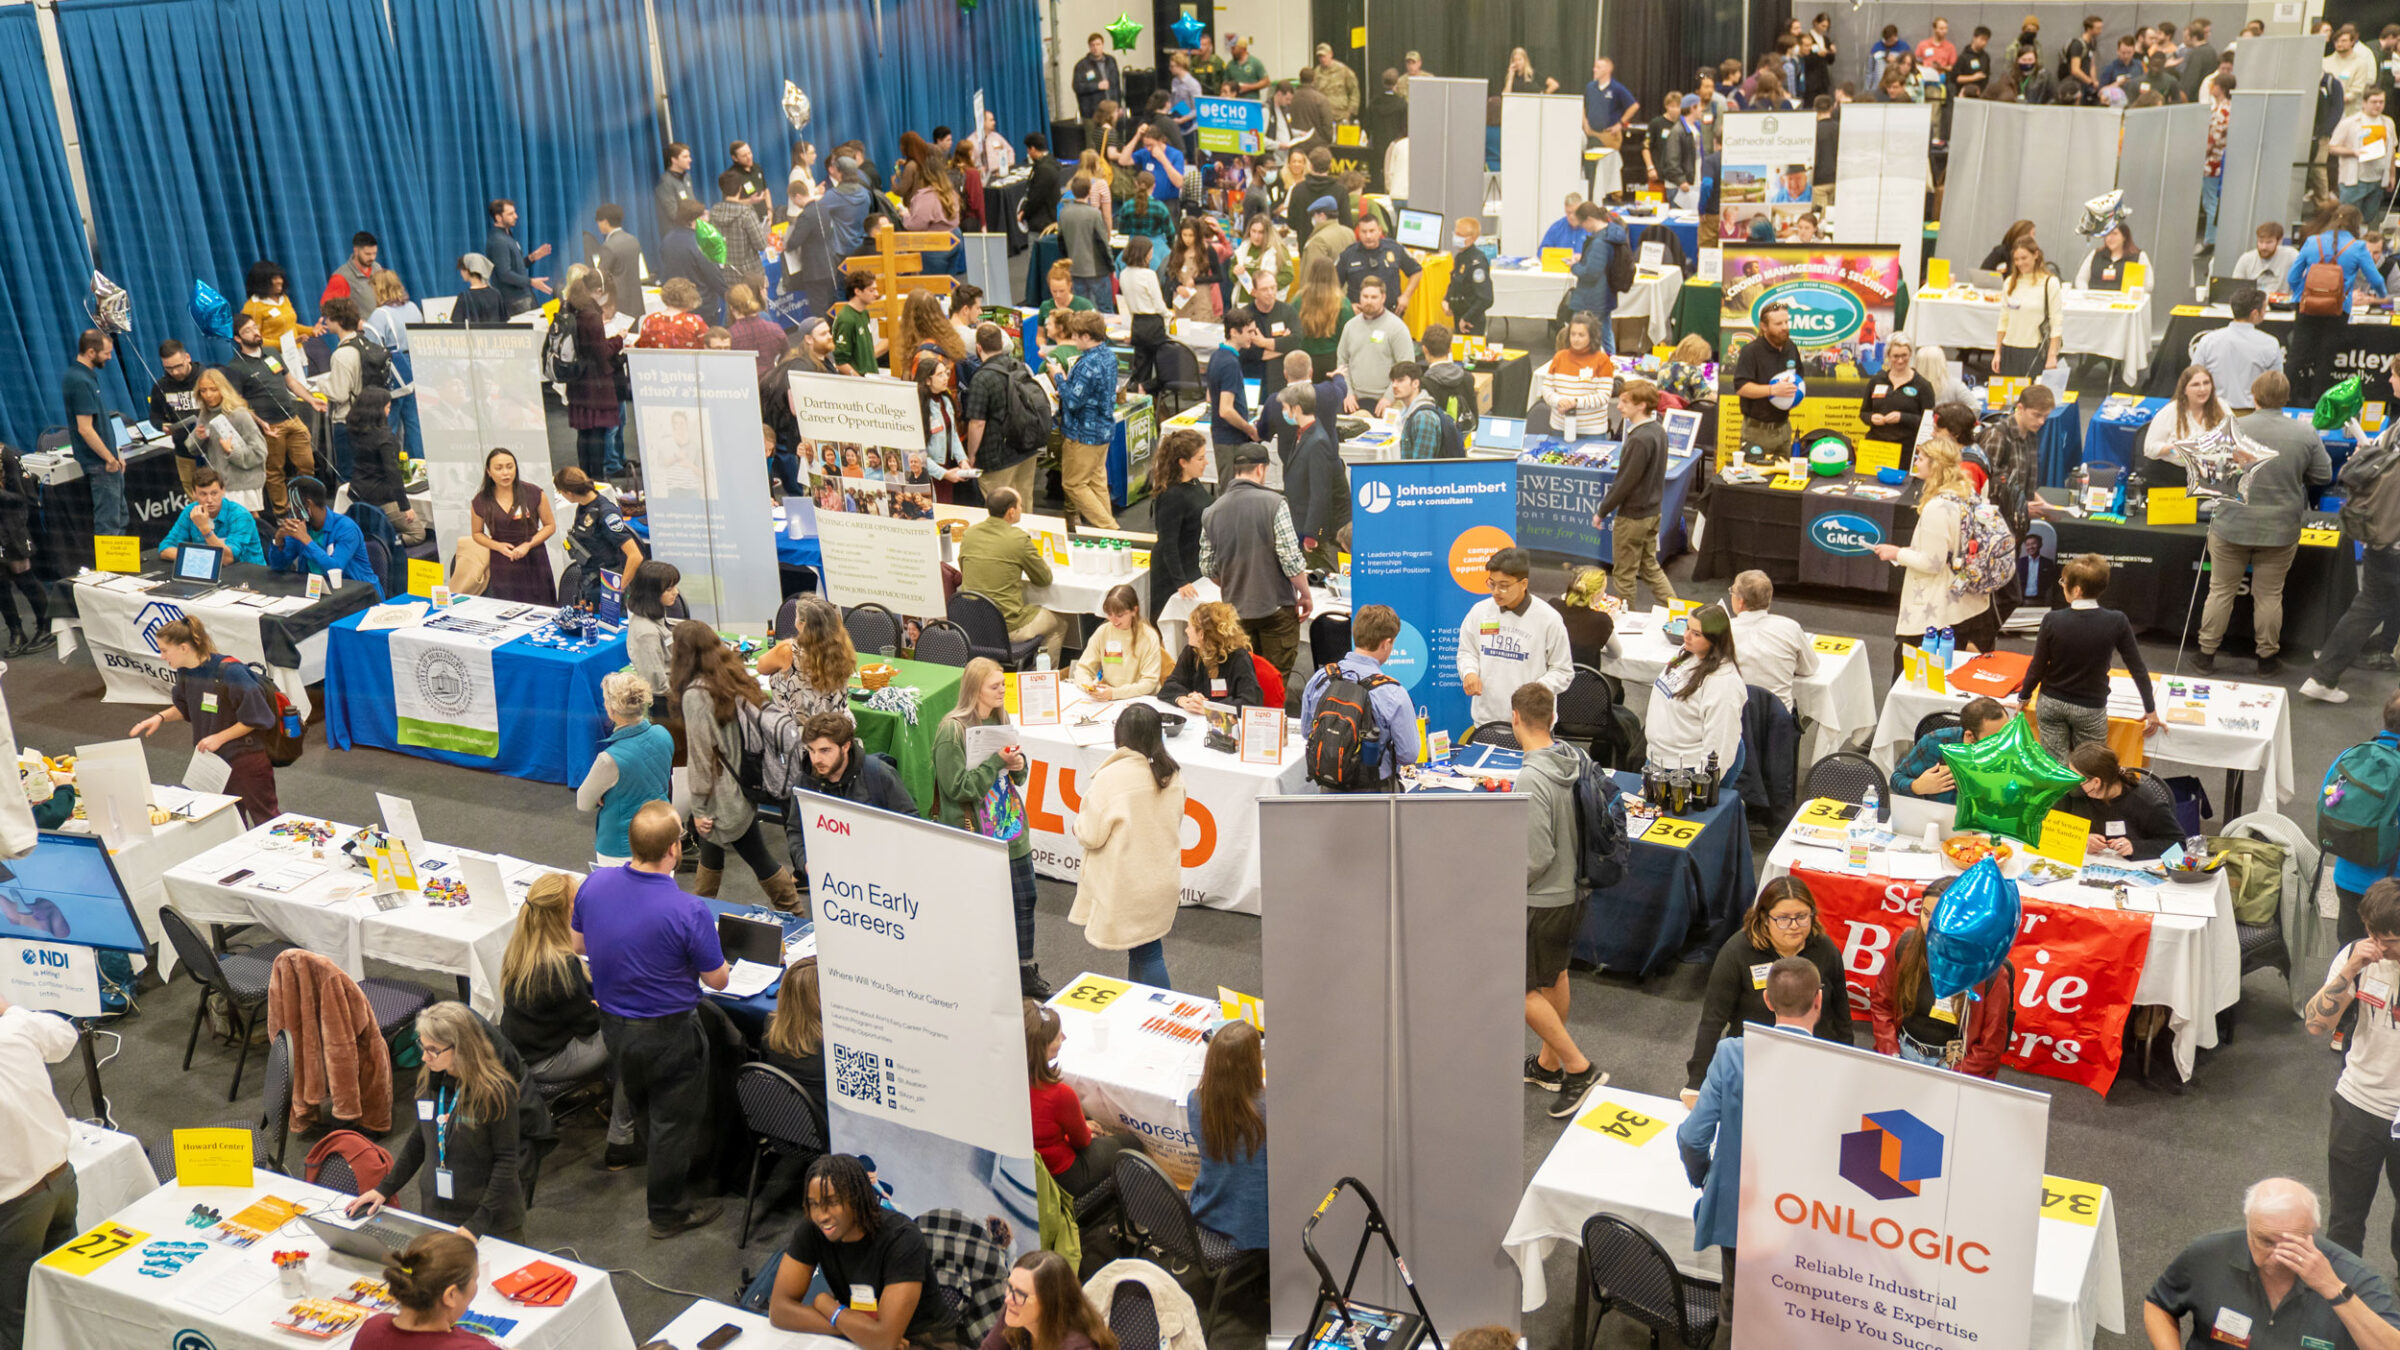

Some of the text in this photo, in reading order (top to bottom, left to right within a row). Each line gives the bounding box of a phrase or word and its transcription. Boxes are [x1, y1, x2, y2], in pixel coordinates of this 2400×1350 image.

[1725, 136, 1813, 148] Cathedral Square
[1727, 264, 1893, 299] CROWD MANAGEMENT & SECURITY
[2334, 349, 2397, 373] alley
[803, 396, 907, 419] Dartmouth College
[799, 410, 915, 432] Career Opportunities
[1396, 481, 1507, 498] JohnsonLambert
[1396, 499, 1416, 507] cpas
[1425, 497, 1473, 506] consultants
[845, 520, 873, 530] CAREER
[874, 525, 930, 536] OPPORTUNITIES
[1527, 524, 1553, 537] here
[1556, 526, 1575, 539] for
[1826, 532, 1866, 546] GMCS
[1368, 551, 1433, 560] Leadership Programs
[1463, 556, 1491, 564] candid
[1467, 546, 1499, 555] campus
[2115, 555, 2153, 563] UNDERSTOOD
[1368, 560, 1403, 569] Internships
[1368, 567, 1431, 576] Entry-Level Positions
[1491, 634, 1521, 653] 1986
[145, 665, 158, 678] &
[817, 814, 851, 836] AON
[1650, 823, 1696, 840] 36
[2057, 828, 2082, 840] Sanders
[2062, 820, 2085, 832] Senator
[822, 872, 919, 920] Aon Early
[823, 900, 905, 940] Careers
[39, 950, 69, 969] NDI
[828, 968, 959, 1011] Where Will You Start Your Career?
[1070, 985, 1118, 1004] 33
[1600, 1110, 1650, 1138] 34
[183, 1142, 245, 1151] Howard Center
[2040, 1188, 2096, 1215] 34
[1774, 1193, 1991, 1274] ONLOGIC
[67, 1233, 130, 1259] 27
[1794, 1254, 1957, 1310] Reliable Industrial
[1771, 1274, 1979, 1342] Computers & Expertise
[1784, 1301, 1806, 1319] To
[1811, 1308, 1852, 1332] Help
[1856, 1320, 1888, 1342] You
